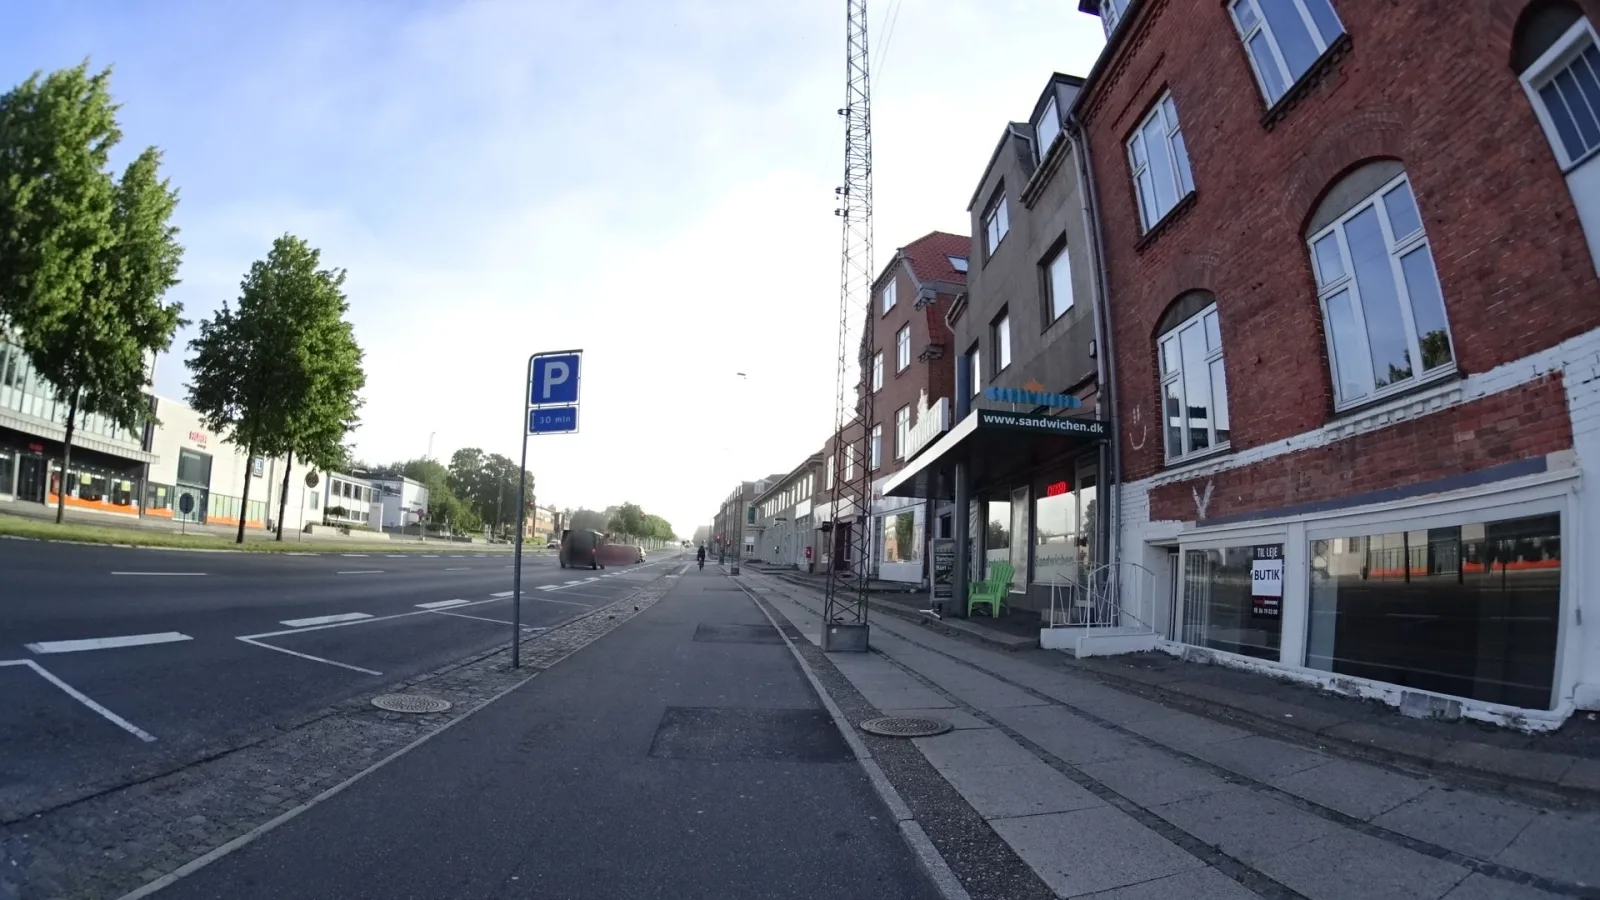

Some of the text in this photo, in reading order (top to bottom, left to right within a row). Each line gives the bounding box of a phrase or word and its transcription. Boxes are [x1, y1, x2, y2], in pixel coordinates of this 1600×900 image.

[542, 361, 570, 399] P
[539, 415, 571, 424] 30 min
[983, 414, 1104, 434] www.sandwichen.dk
[1254, 569, 1280, 581] BUTIK
